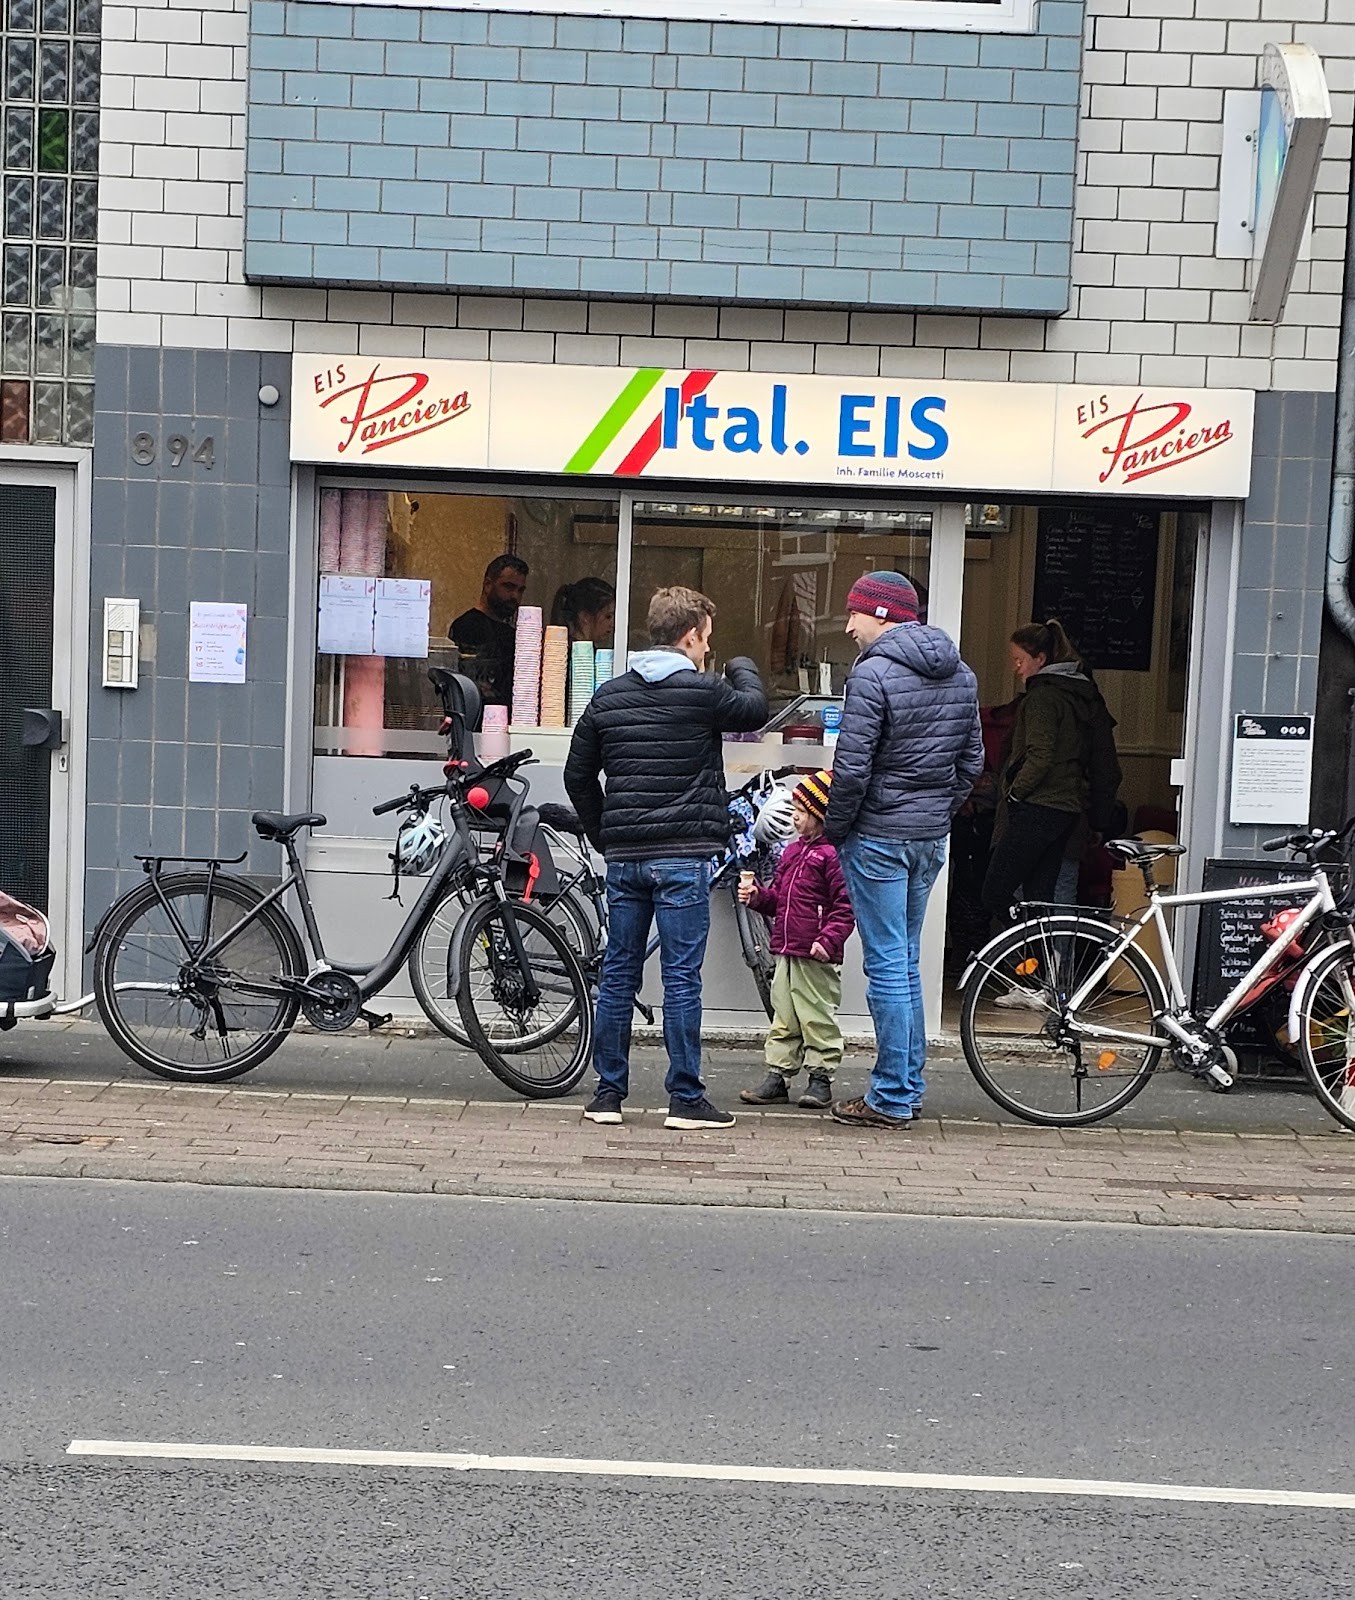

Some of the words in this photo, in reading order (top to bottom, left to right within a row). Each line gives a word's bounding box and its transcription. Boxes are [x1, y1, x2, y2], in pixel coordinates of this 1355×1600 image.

[314, 363, 346, 394] EIS
[319, 363, 471, 455] Panciera
[662, 385, 809, 455] Ital.
[838, 394, 949, 460] EIS
[1077, 394, 1109, 425] EIS
[131, 431, 215, 470] 894
[1082, 393, 1233, 485] Panciera
[836, 466, 856, 476] Inh.
[858, 467, 895, 478] Familie
